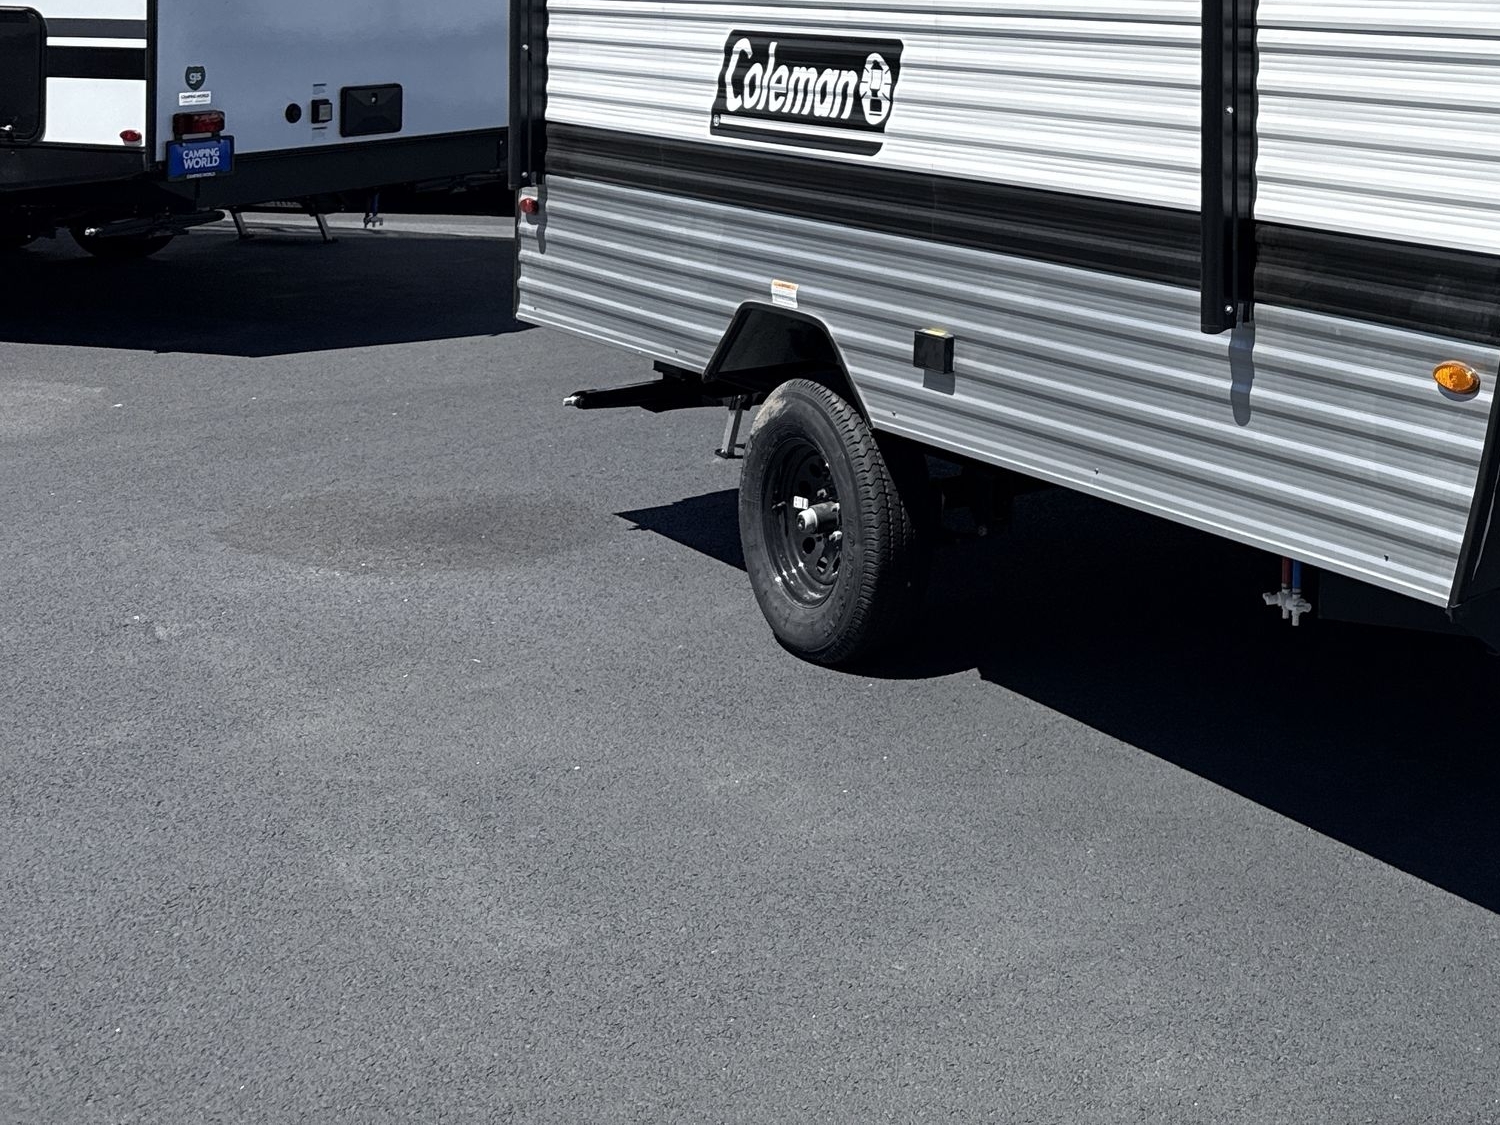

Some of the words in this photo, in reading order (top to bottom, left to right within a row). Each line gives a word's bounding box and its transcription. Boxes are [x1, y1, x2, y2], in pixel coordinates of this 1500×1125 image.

[725, 38, 859, 120] Coleman
[183, 147, 220, 160] CAMPING
[183, 157, 220, 170] WORLD
